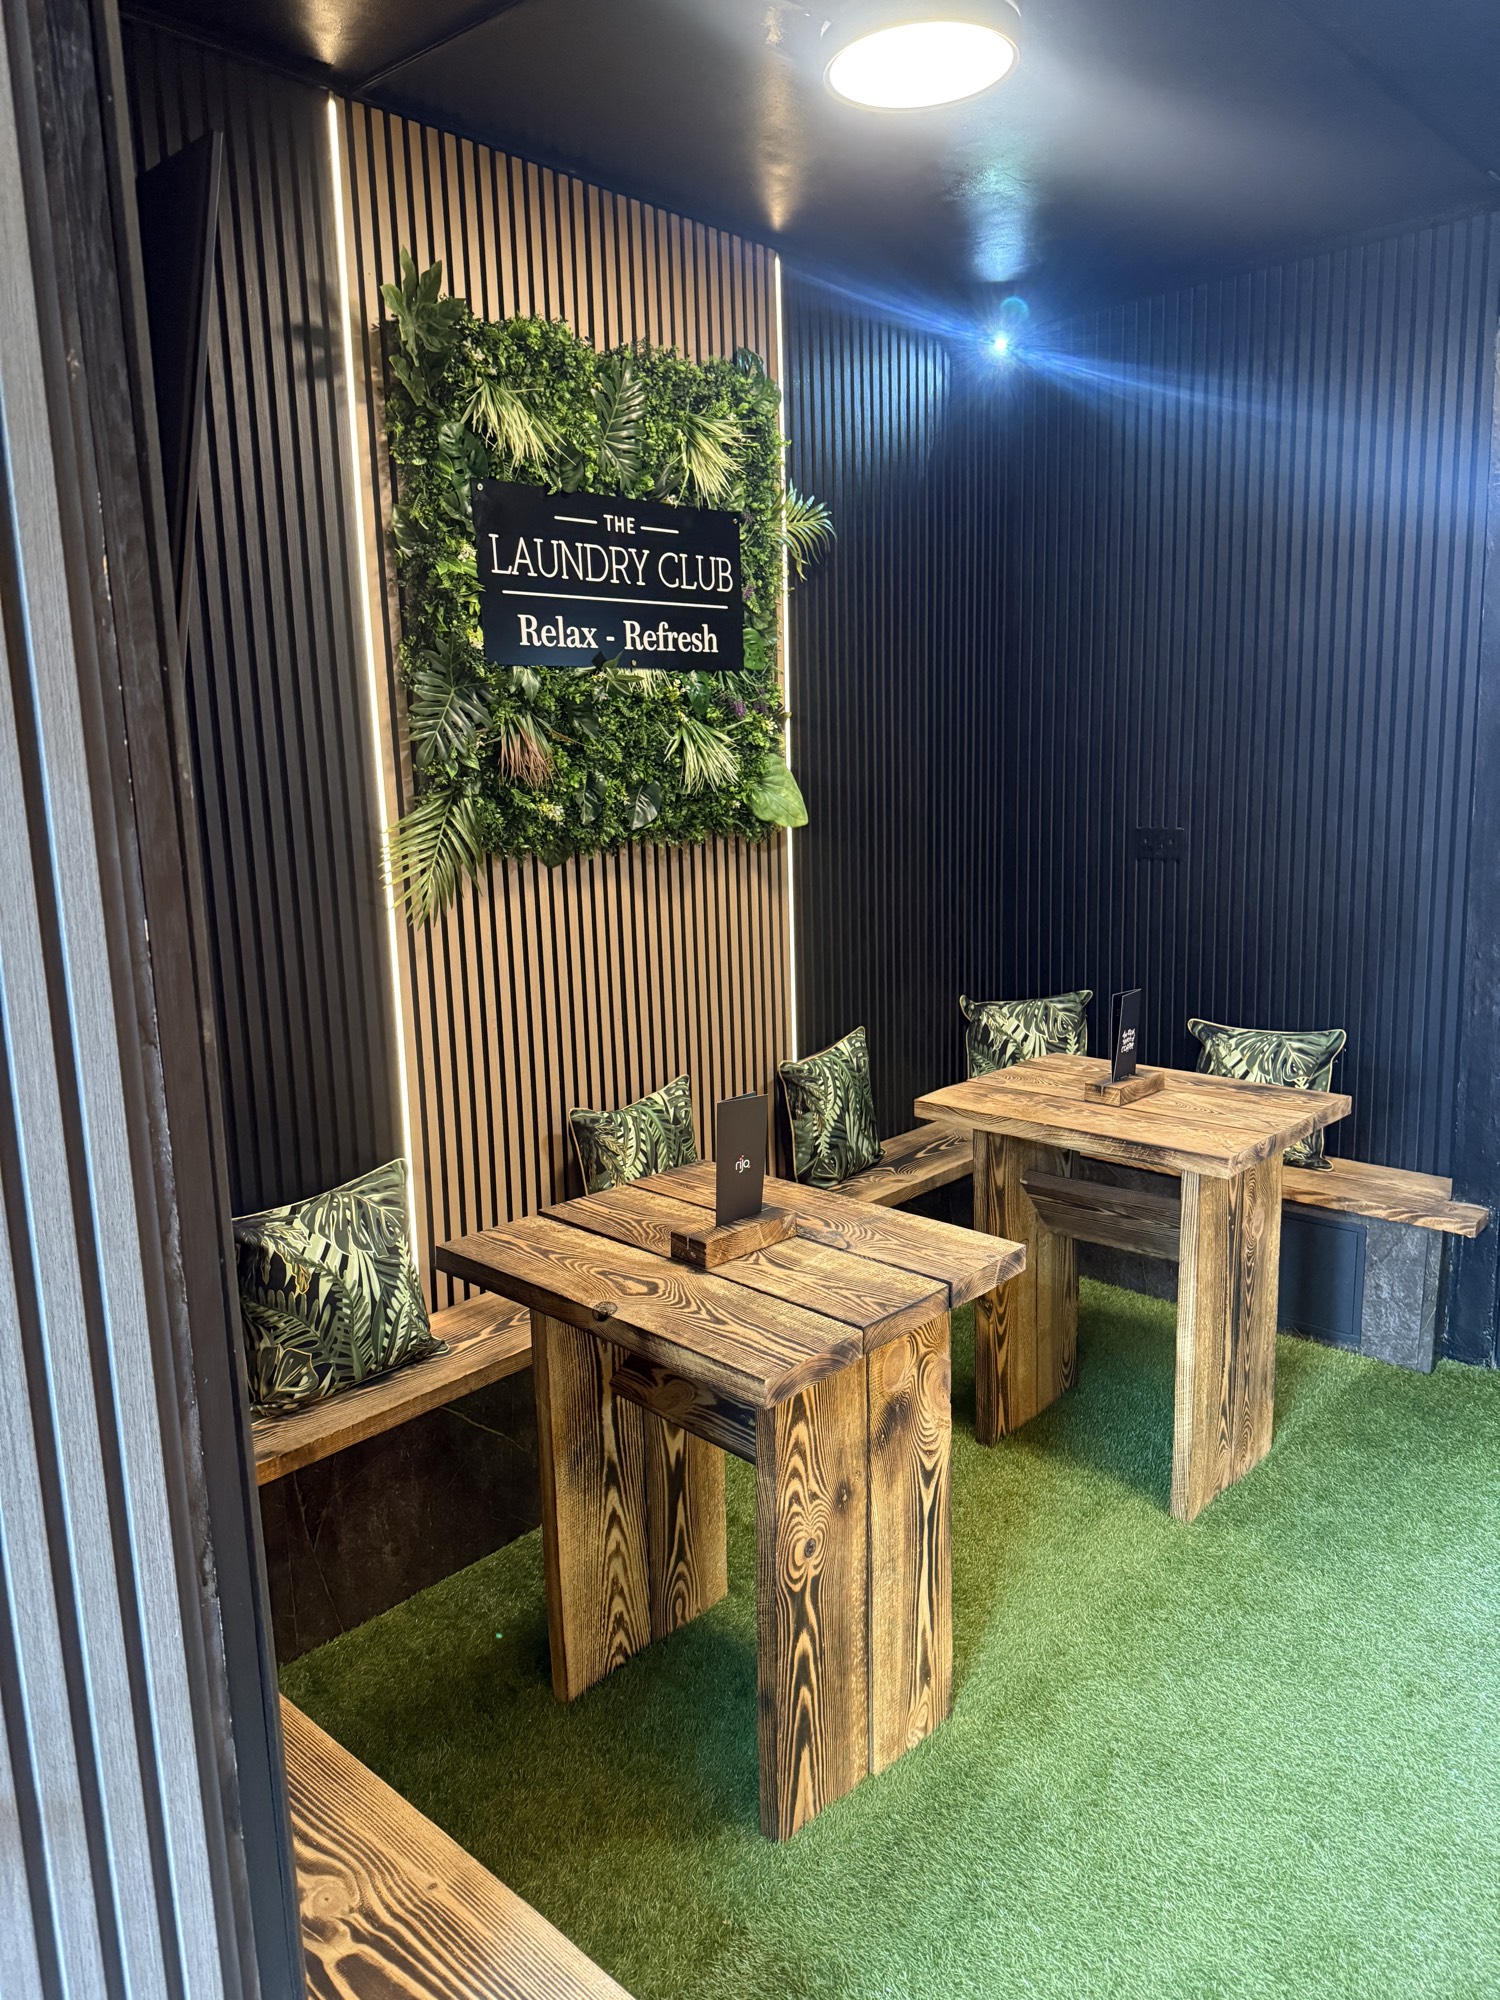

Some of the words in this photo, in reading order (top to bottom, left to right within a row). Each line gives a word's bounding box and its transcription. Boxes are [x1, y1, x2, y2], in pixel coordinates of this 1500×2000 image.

[603, 514, 636, 535] THE
[488, 533, 650, 586] LAUNDRY
[658, 552, 734, 593] CLUB
[517, 613, 599, 649] Relax
[622, 620, 719, 653] Refresh
